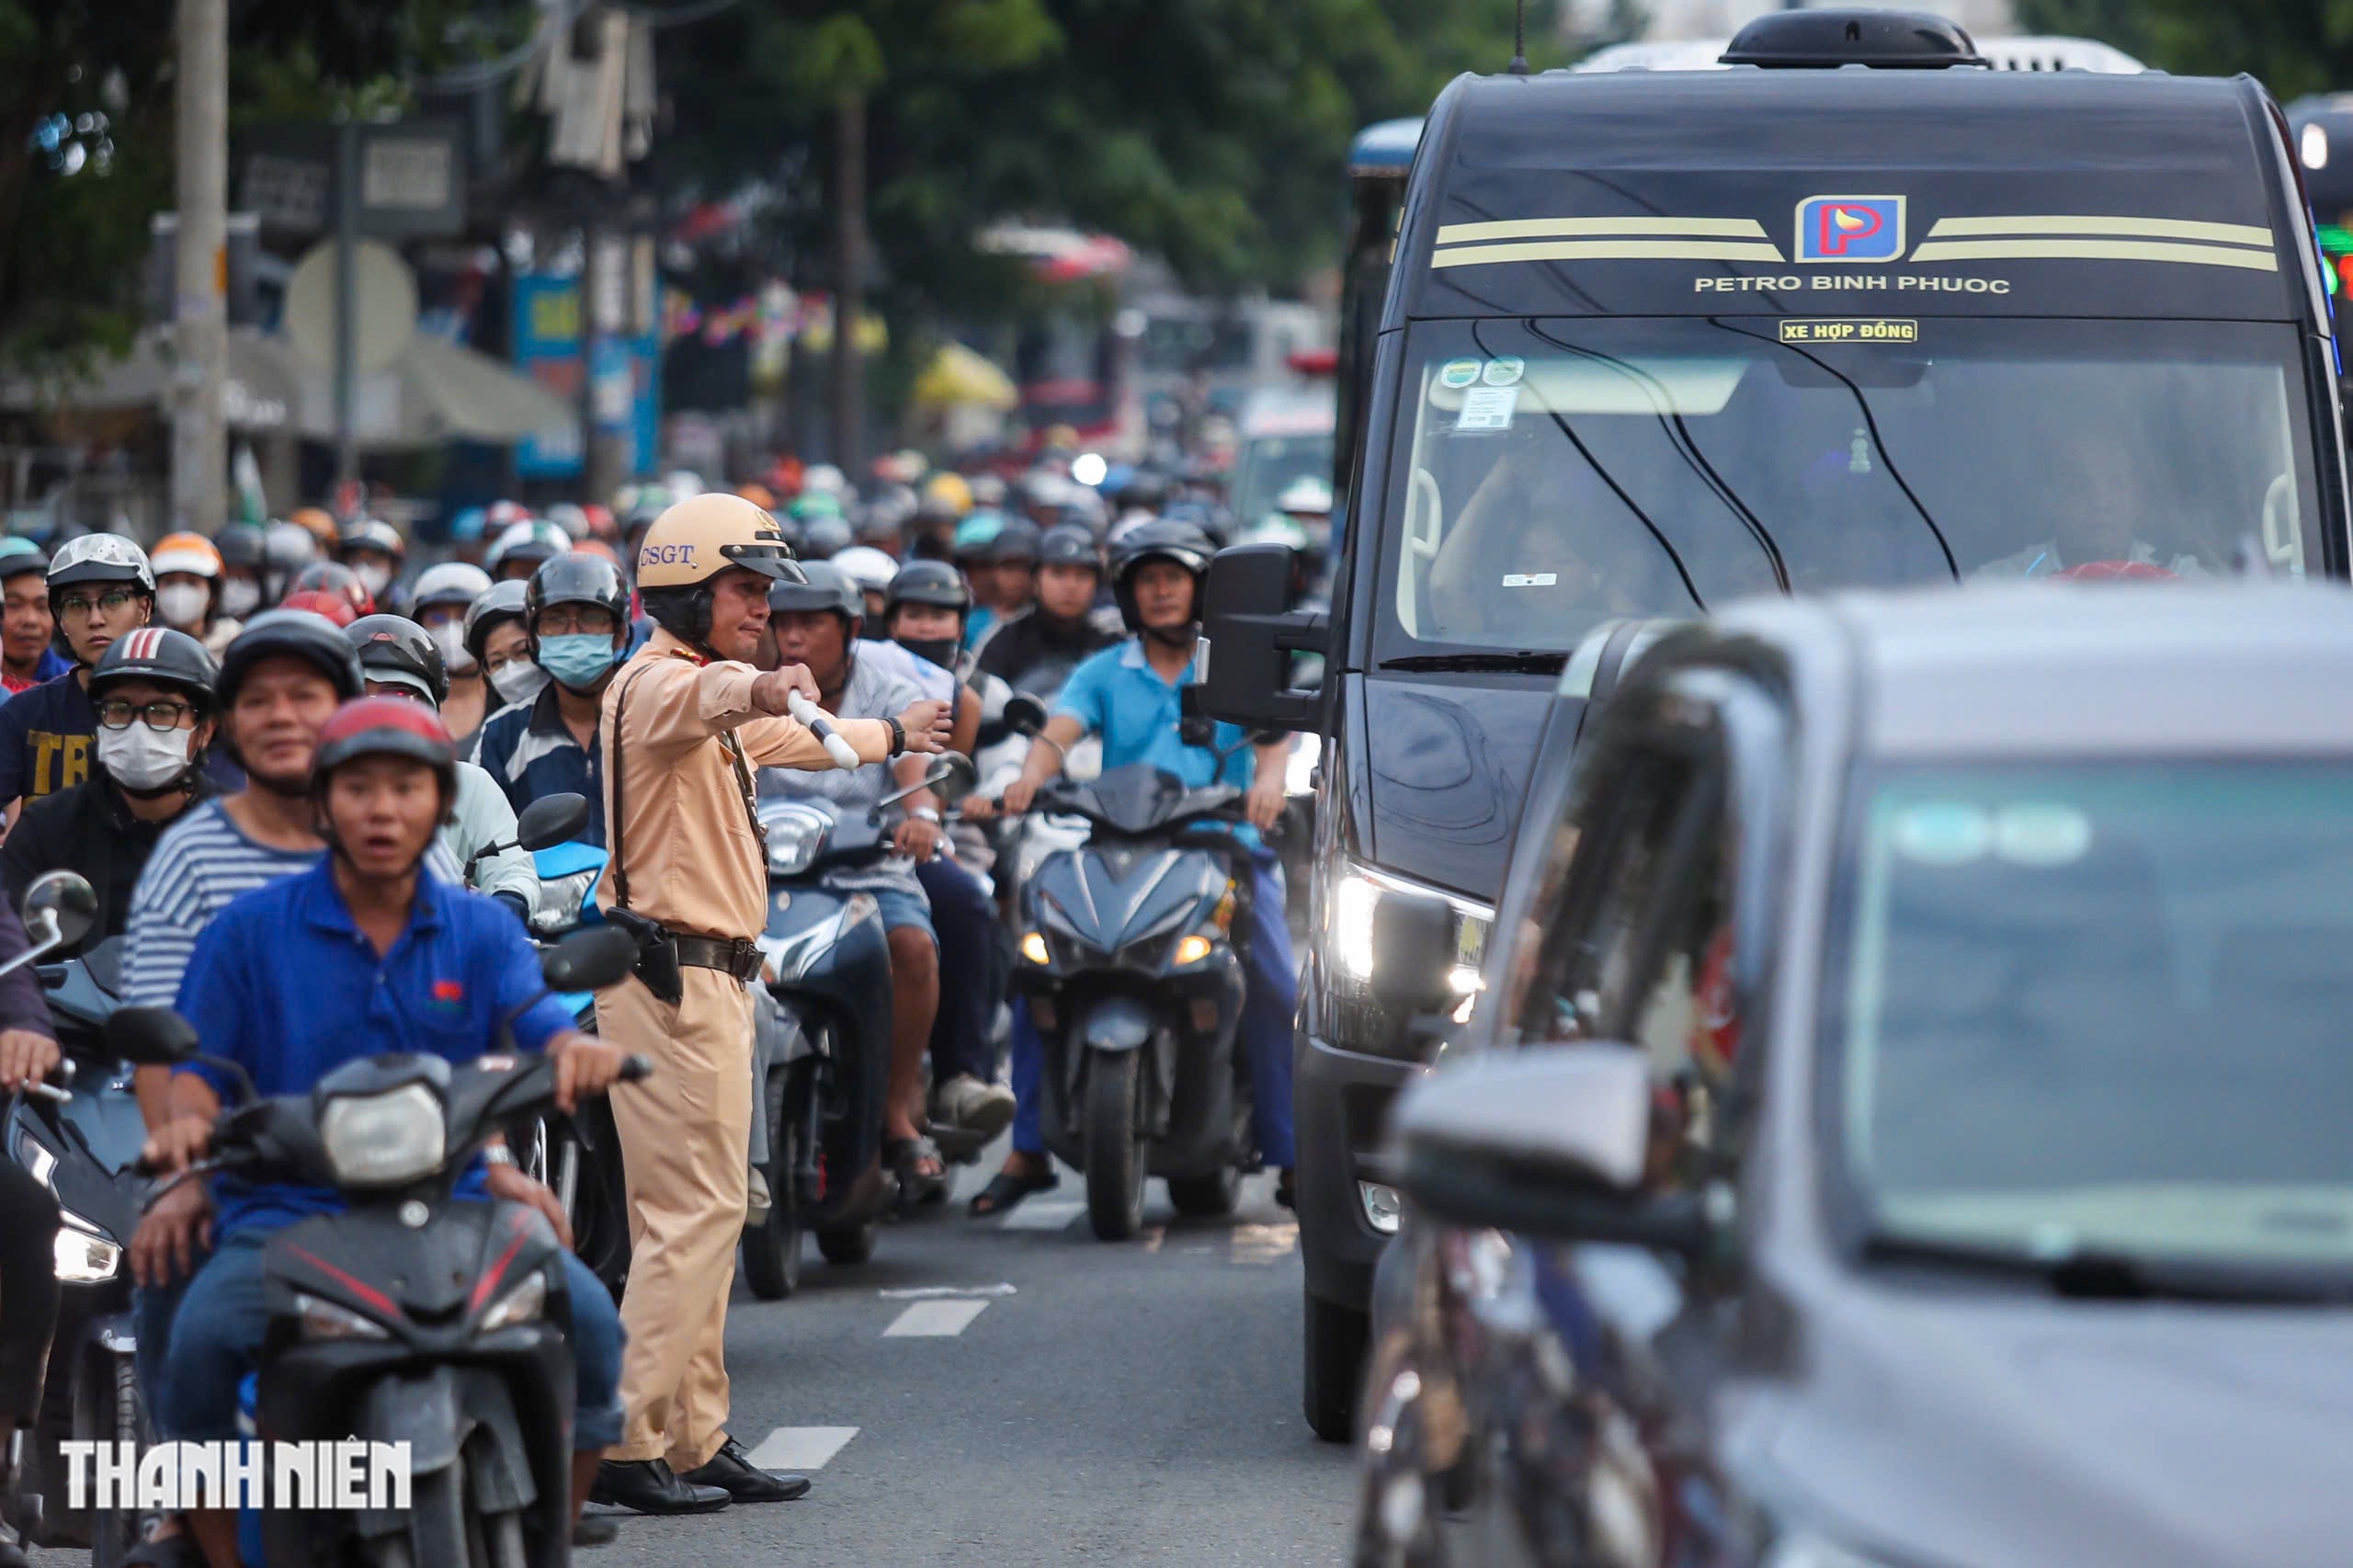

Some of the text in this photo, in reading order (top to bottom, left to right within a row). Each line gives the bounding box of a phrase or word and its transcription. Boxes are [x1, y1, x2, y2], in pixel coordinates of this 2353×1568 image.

[1694, 276, 2011, 294] PETRO BINH PHUOC
[1784, 325, 1809, 338] XE
[1813, 323, 1855, 340] HỢP
[641, 544, 695, 566] CSGT
